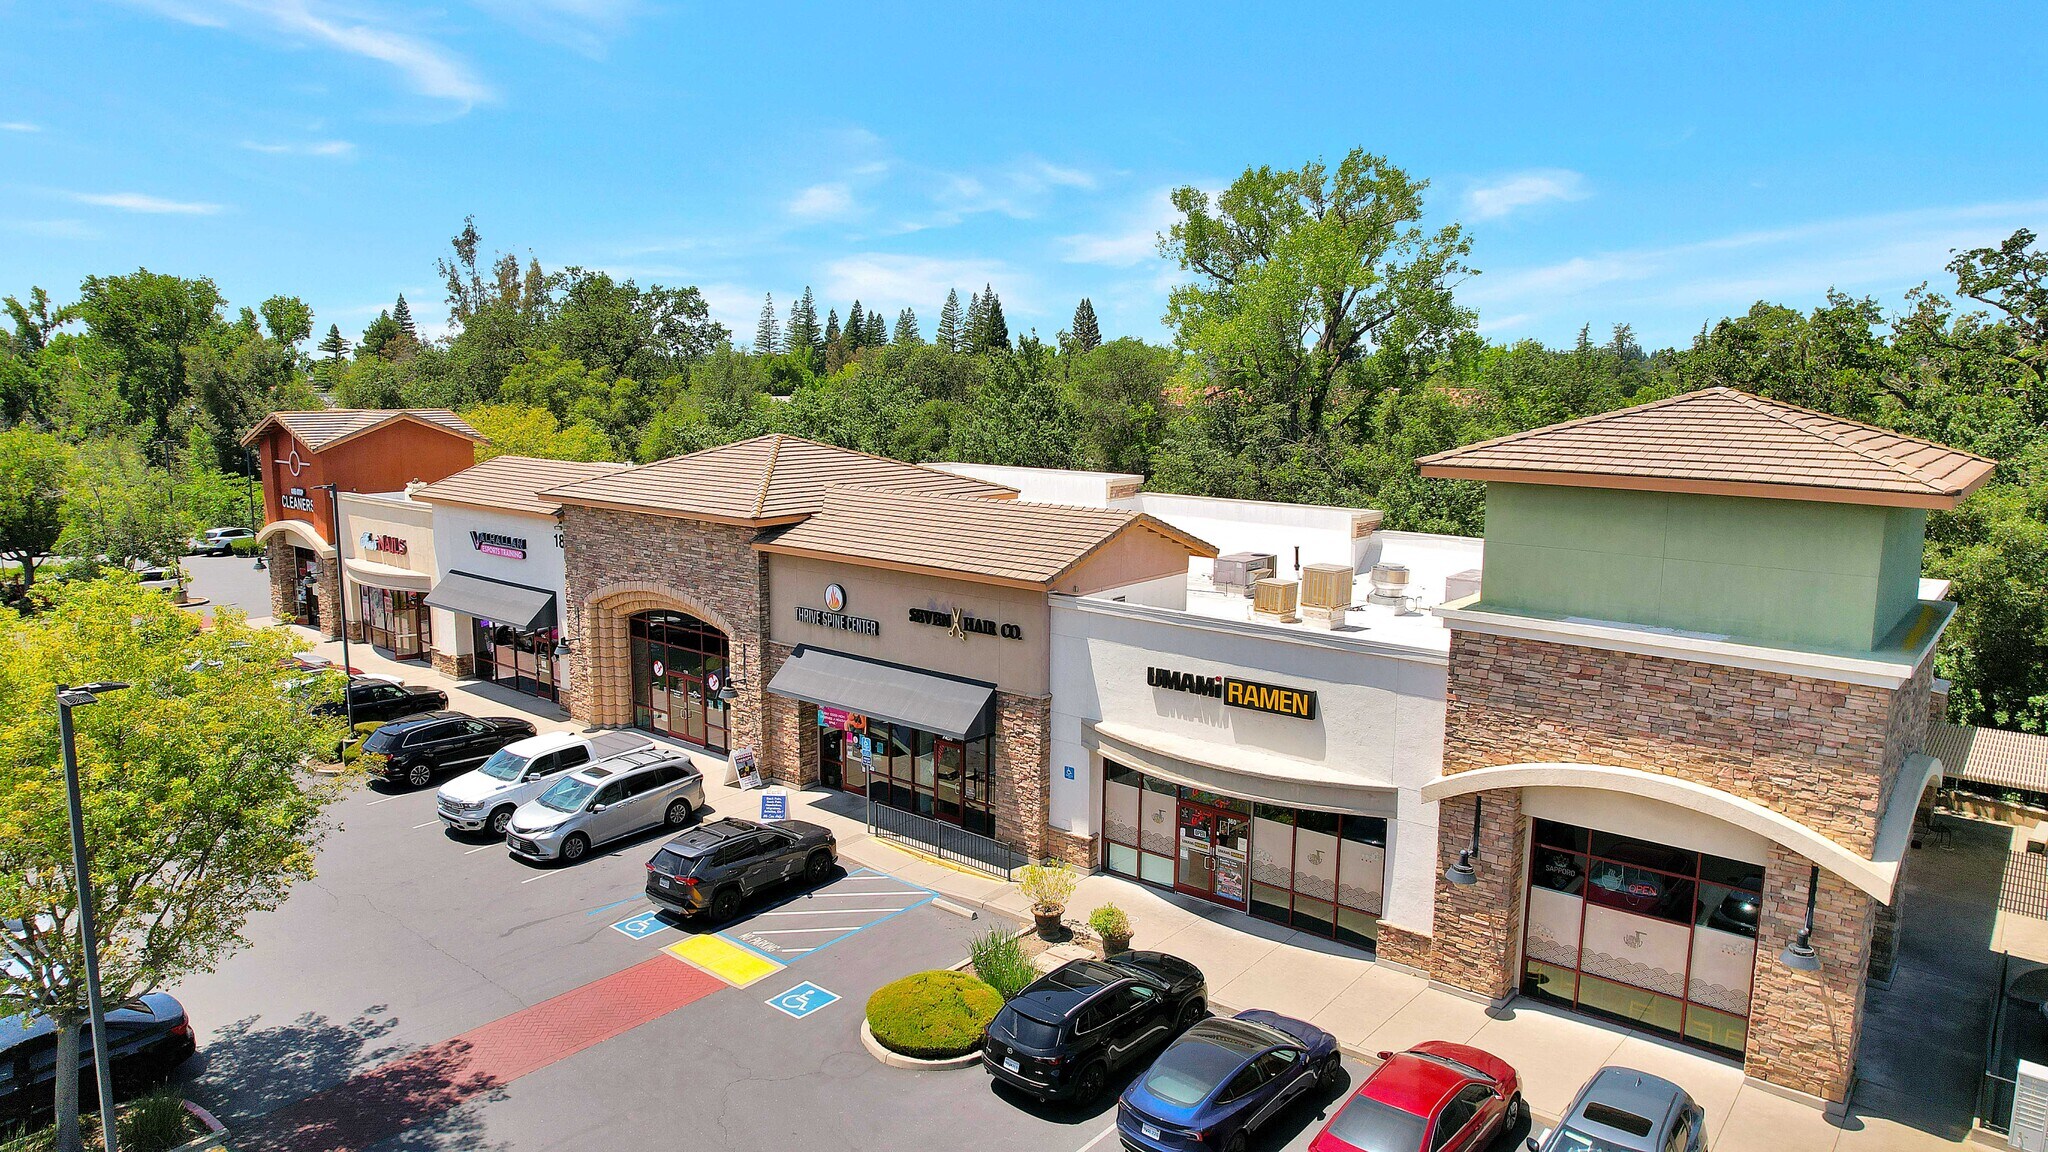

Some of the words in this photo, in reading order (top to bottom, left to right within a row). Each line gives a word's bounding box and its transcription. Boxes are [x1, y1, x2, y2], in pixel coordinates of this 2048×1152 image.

[376, 534, 407, 556] NAILS
[482, 545, 501, 555] ESPORTS
[501, 549, 523, 559] TRAINING
[795, 607, 820, 626] THRIVE
[822, 612, 845, 630] SPINE
[847, 616, 877, 636] CENTER
[908, 608, 952, 628] SEVEN
[963, 616, 997, 636] HAIR
[1001, 623, 1023, 640] CO.
[1228, 681, 1309, 716] RAMEN
[1545, 864, 1576, 877] SAPPORO
[1628, 883, 1658, 896] OPEN
